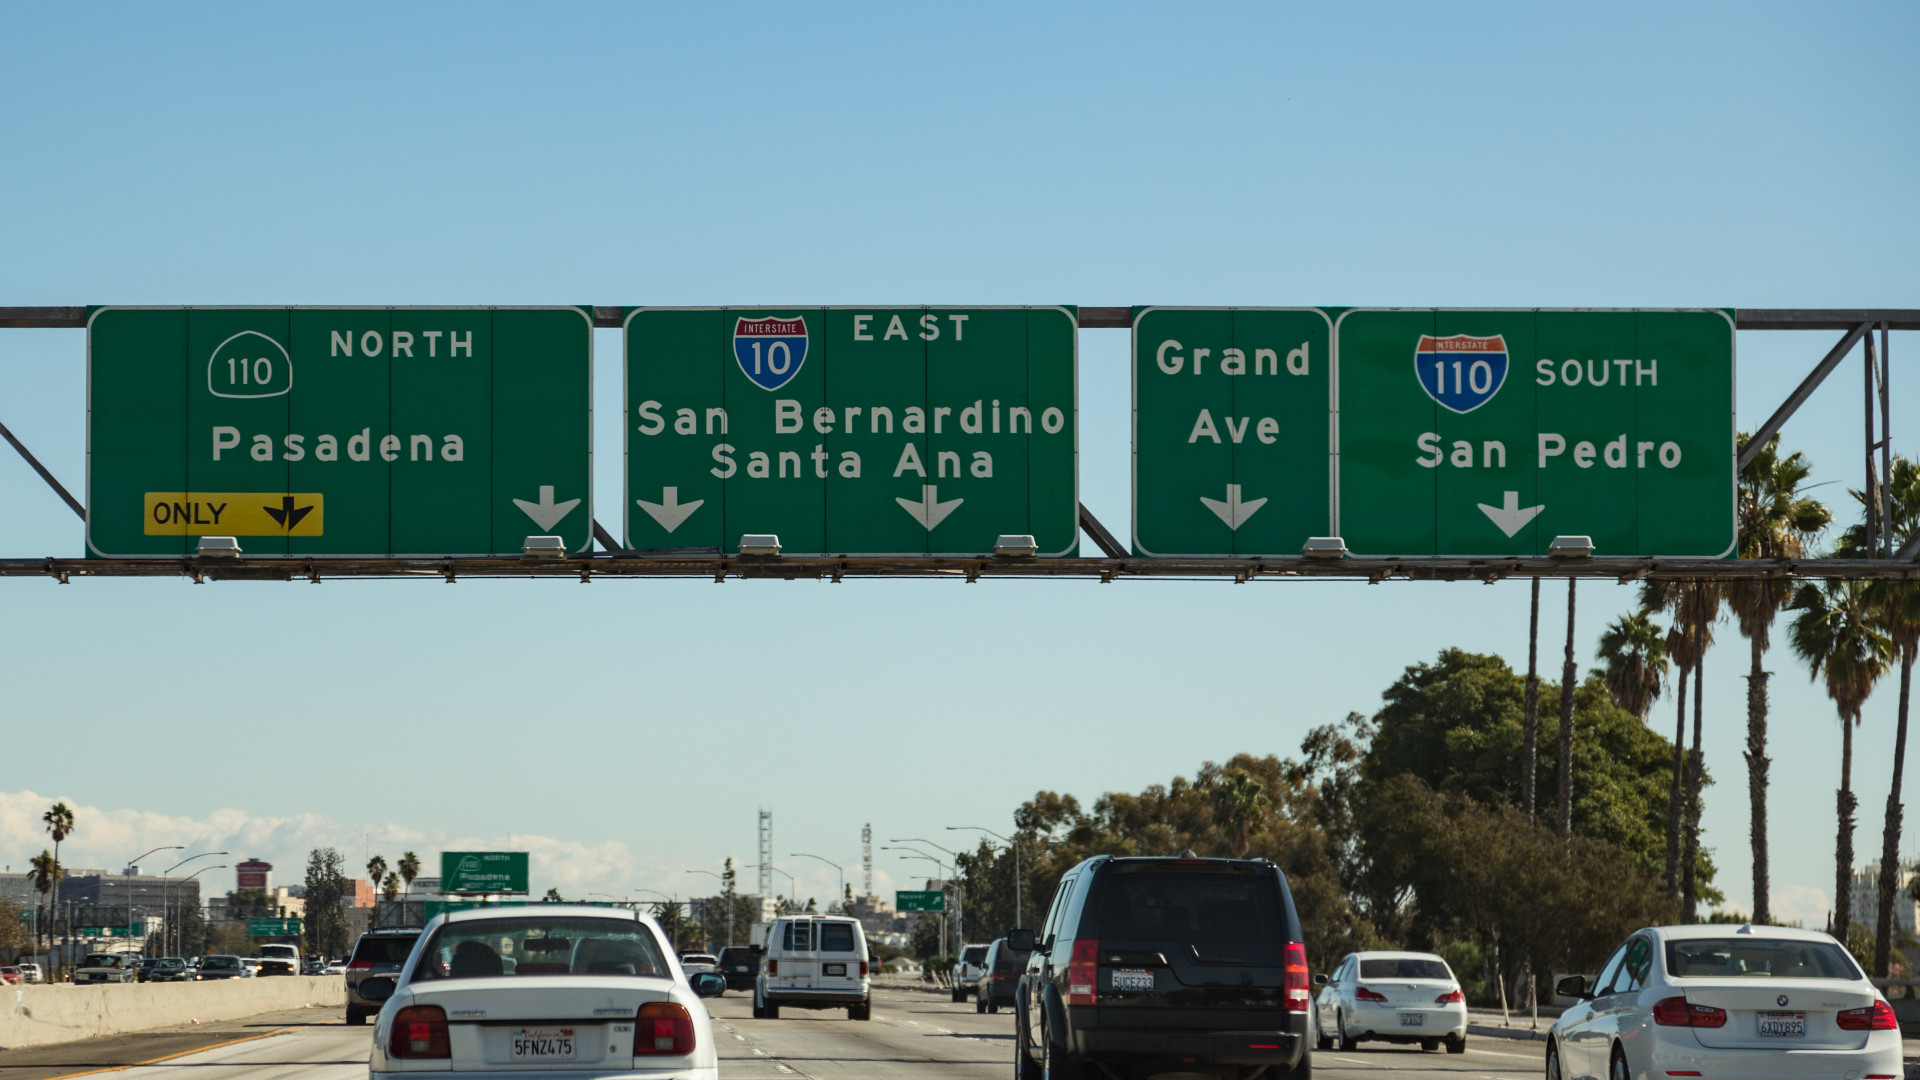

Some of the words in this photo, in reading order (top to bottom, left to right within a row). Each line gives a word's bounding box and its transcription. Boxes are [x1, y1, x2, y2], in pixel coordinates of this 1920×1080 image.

[744, 324, 797, 333] INTERSTATE
[854, 314, 969, 341] EAST
[331, 330, 473, 357] NORTH
[1156, 339, 1309, 375] Grand
[228, 357, 272, 385] 110
[751, 341, 791, 375] 10
[1435, 360, 1492, 394] 110
[1536, 359, 1657, 387] SOUTH
[638, 400, 728, 435] San
[775, 399, 1065, 434] Bernardino
[1188, 408, 1279, 444] Ave
[212, 426, 464, 462] Pasadena
[1416, 433, 1506, 468] San
[1538, 433, 1682, 469] Pedro
[710, 443, 861, 478] Santa
[893, 442, 994, 478] Ana
[153, 502, 227, 525] ONLY
[523, 1031, 560, 1040] California
[1761, 1021, 1803, 1033] 6XDY895
[515, 1039, 571, 1056] 5FNZ475
